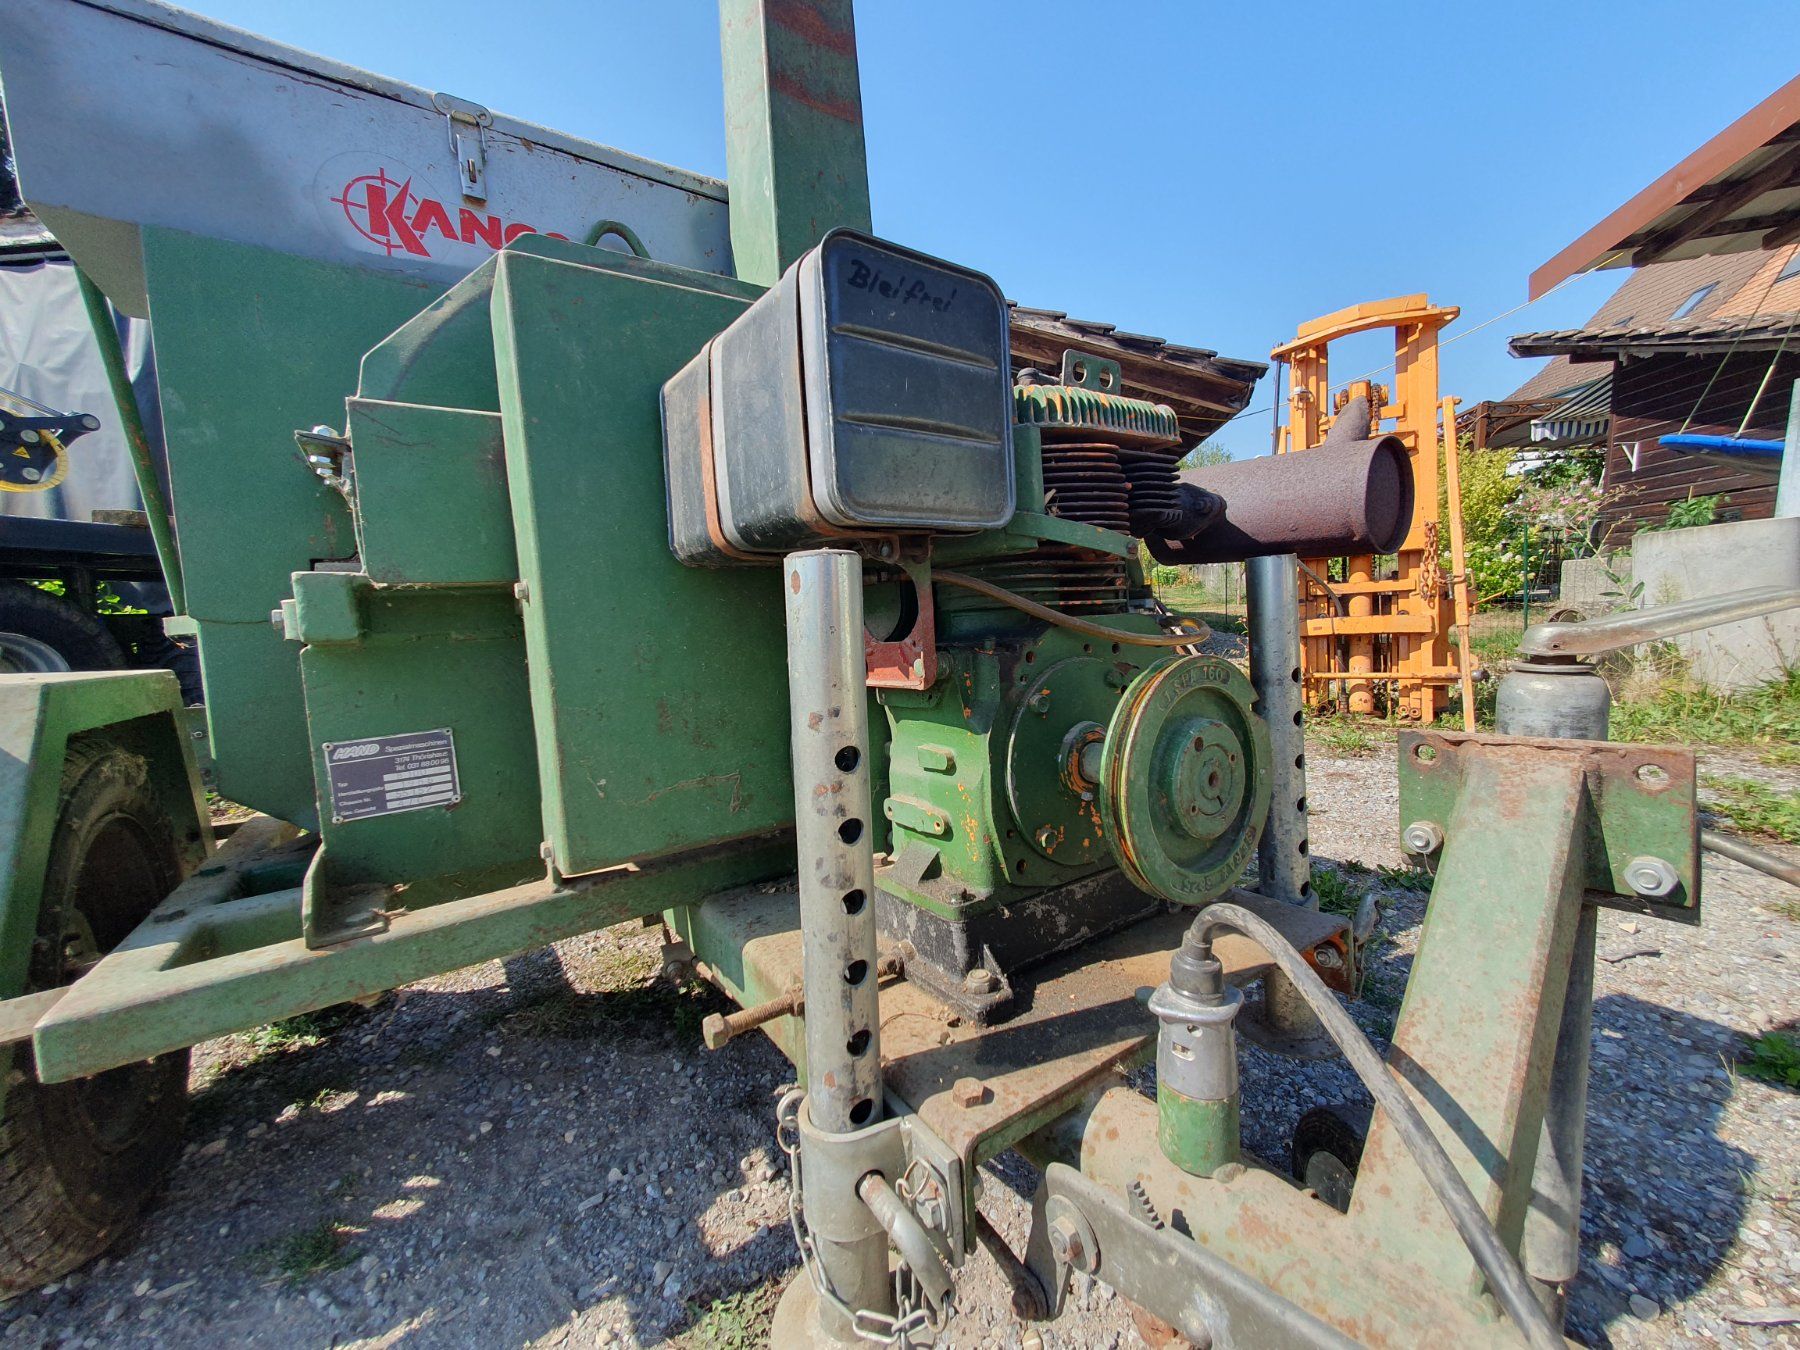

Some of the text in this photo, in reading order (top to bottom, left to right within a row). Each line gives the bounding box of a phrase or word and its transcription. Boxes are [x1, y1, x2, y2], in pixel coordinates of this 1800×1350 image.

[365, 175, 569, 258] KAN
[848, 259, 957, 312] Bleifrei
[1203, 666, 1223, 681] 160
[333, 740, 448, 760] HAND Spezialmaschinen
